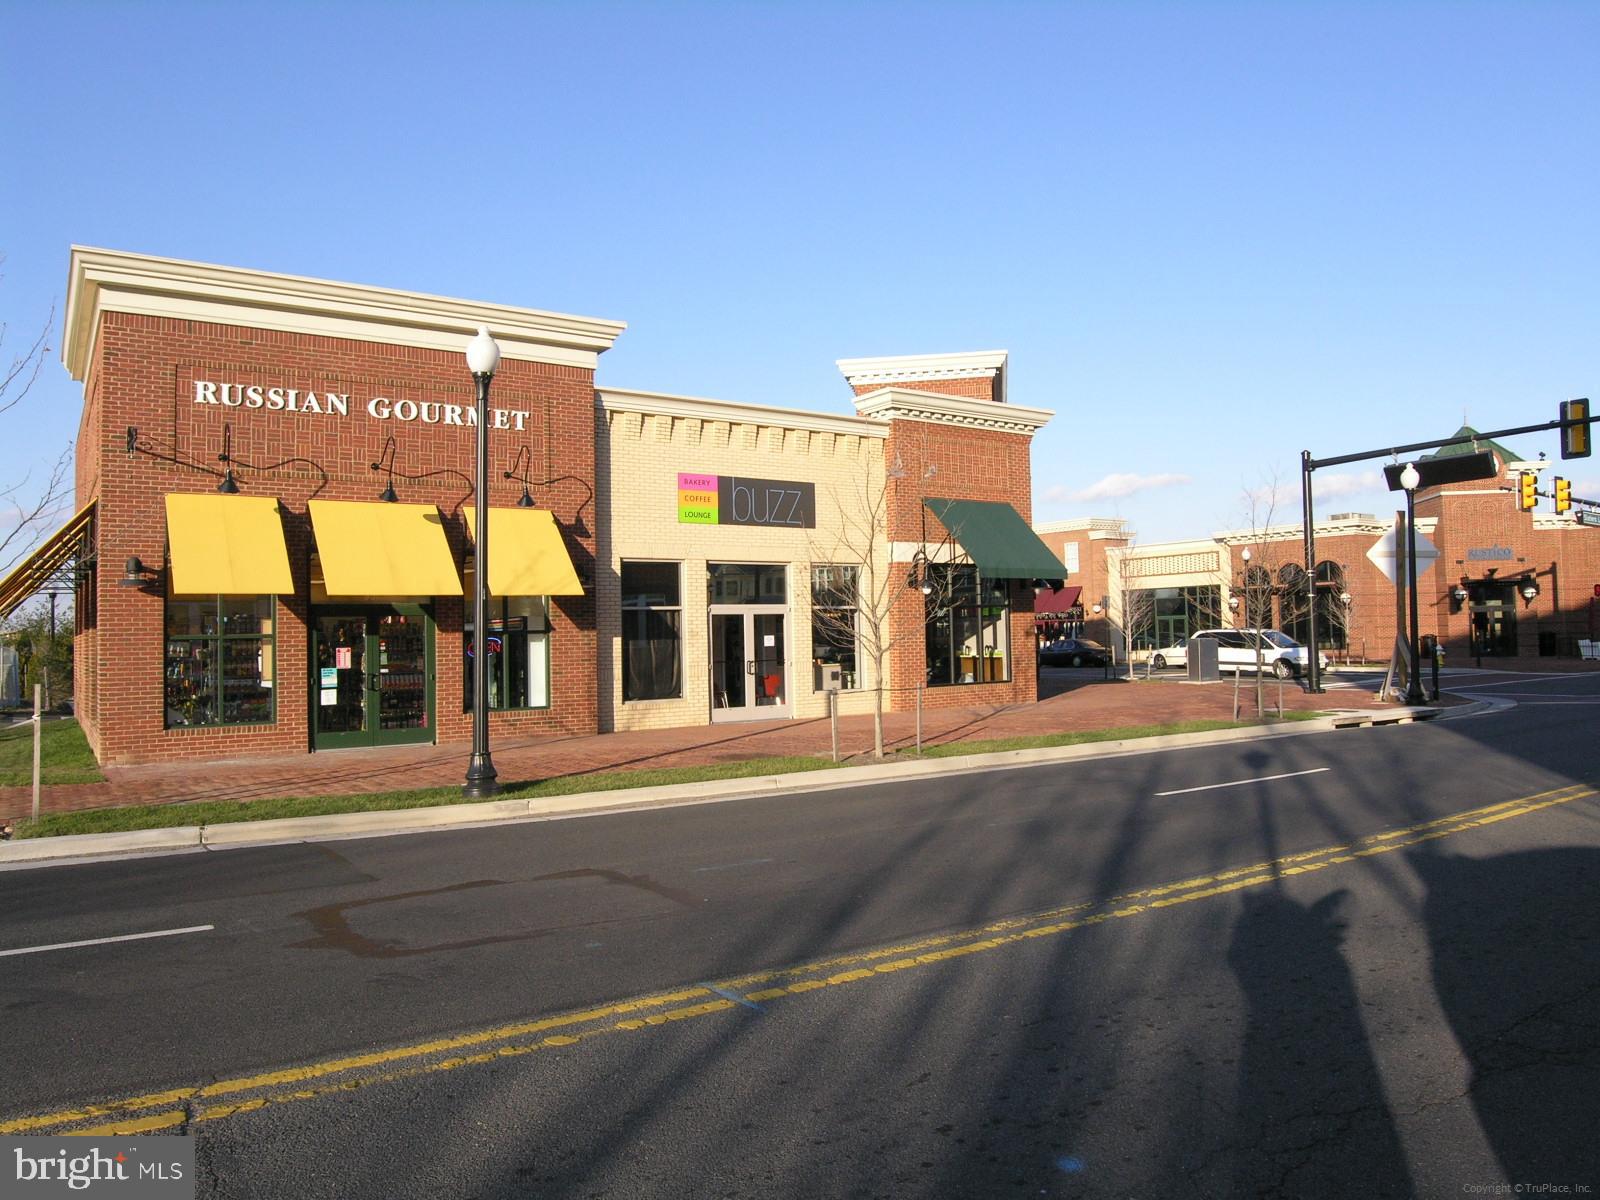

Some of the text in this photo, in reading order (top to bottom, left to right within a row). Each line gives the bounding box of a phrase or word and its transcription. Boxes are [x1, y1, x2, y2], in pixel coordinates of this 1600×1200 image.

[193, 380, 350, 416] RUSSIAN
[684, 478, 711, 486] BAKERY
[684, 495, 711, 503] COFFEE
[732, 477, 801, 525] buzz
[684, 511, 711, 519] LOUNGE
